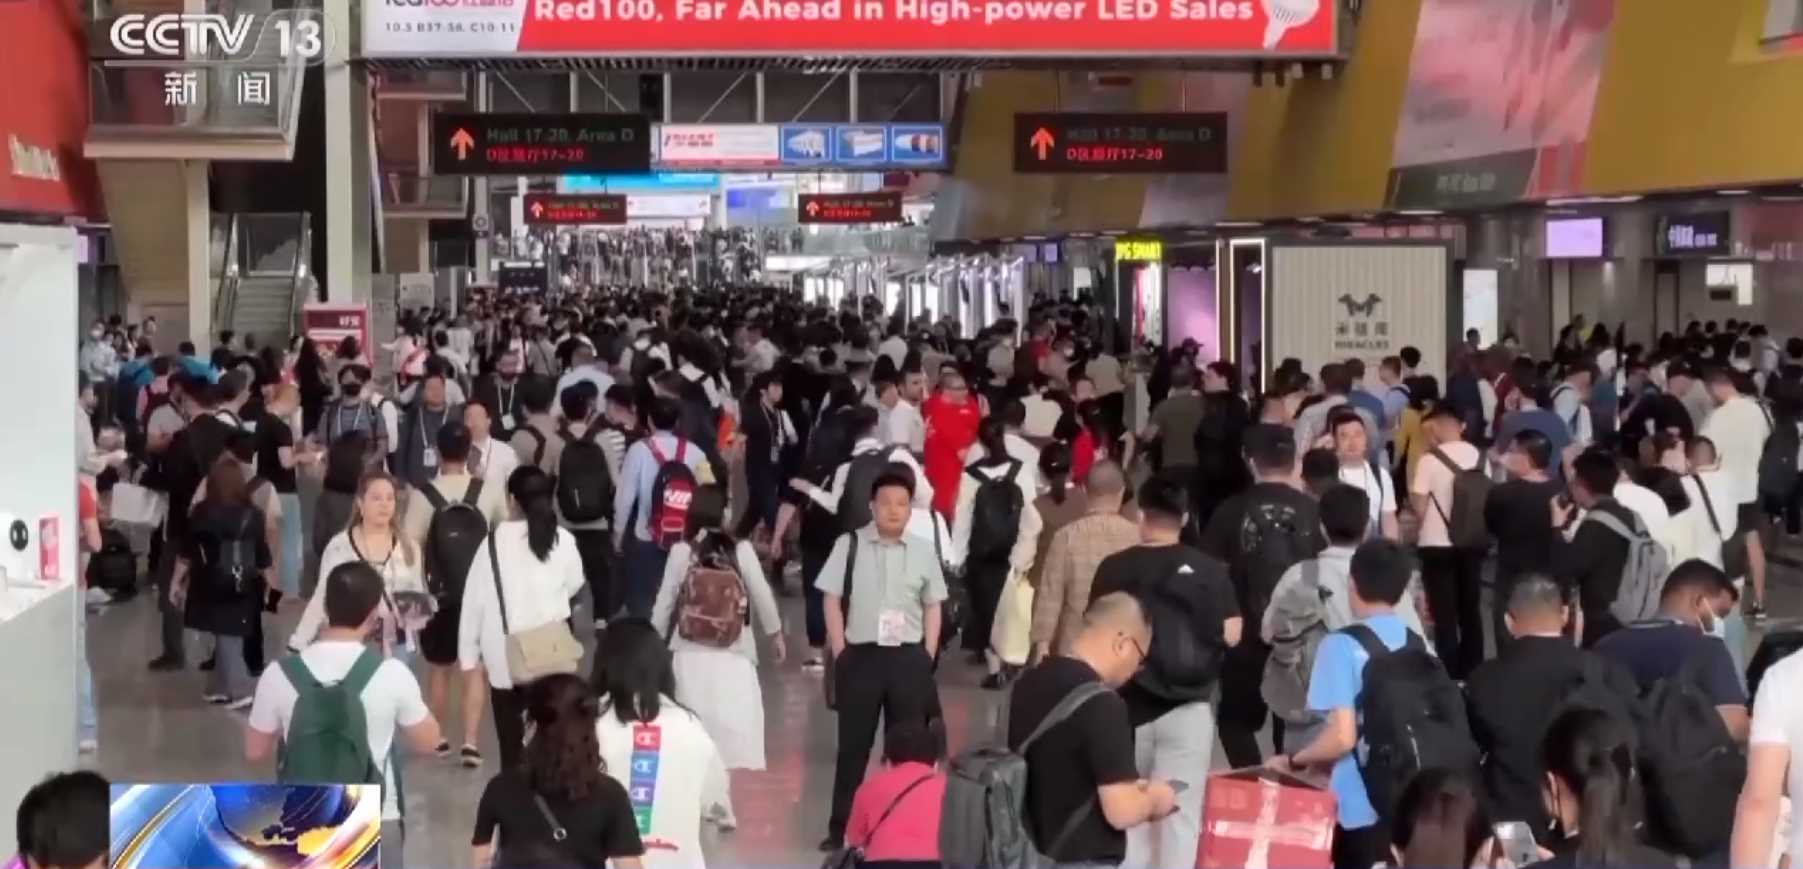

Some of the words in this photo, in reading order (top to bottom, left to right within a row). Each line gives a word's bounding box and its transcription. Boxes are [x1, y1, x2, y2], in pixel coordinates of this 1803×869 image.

[535, 0, 663, 21] Red100,
[676, 0, 727, 20] Far
[738, 0, 841, 20] Ahead
[854, 0, 884, 20] in
[896, 0, 1084, 25] High-power
[1098, 0, 1158, 20] LED
[1169, 0, 1254, 20] Sales
